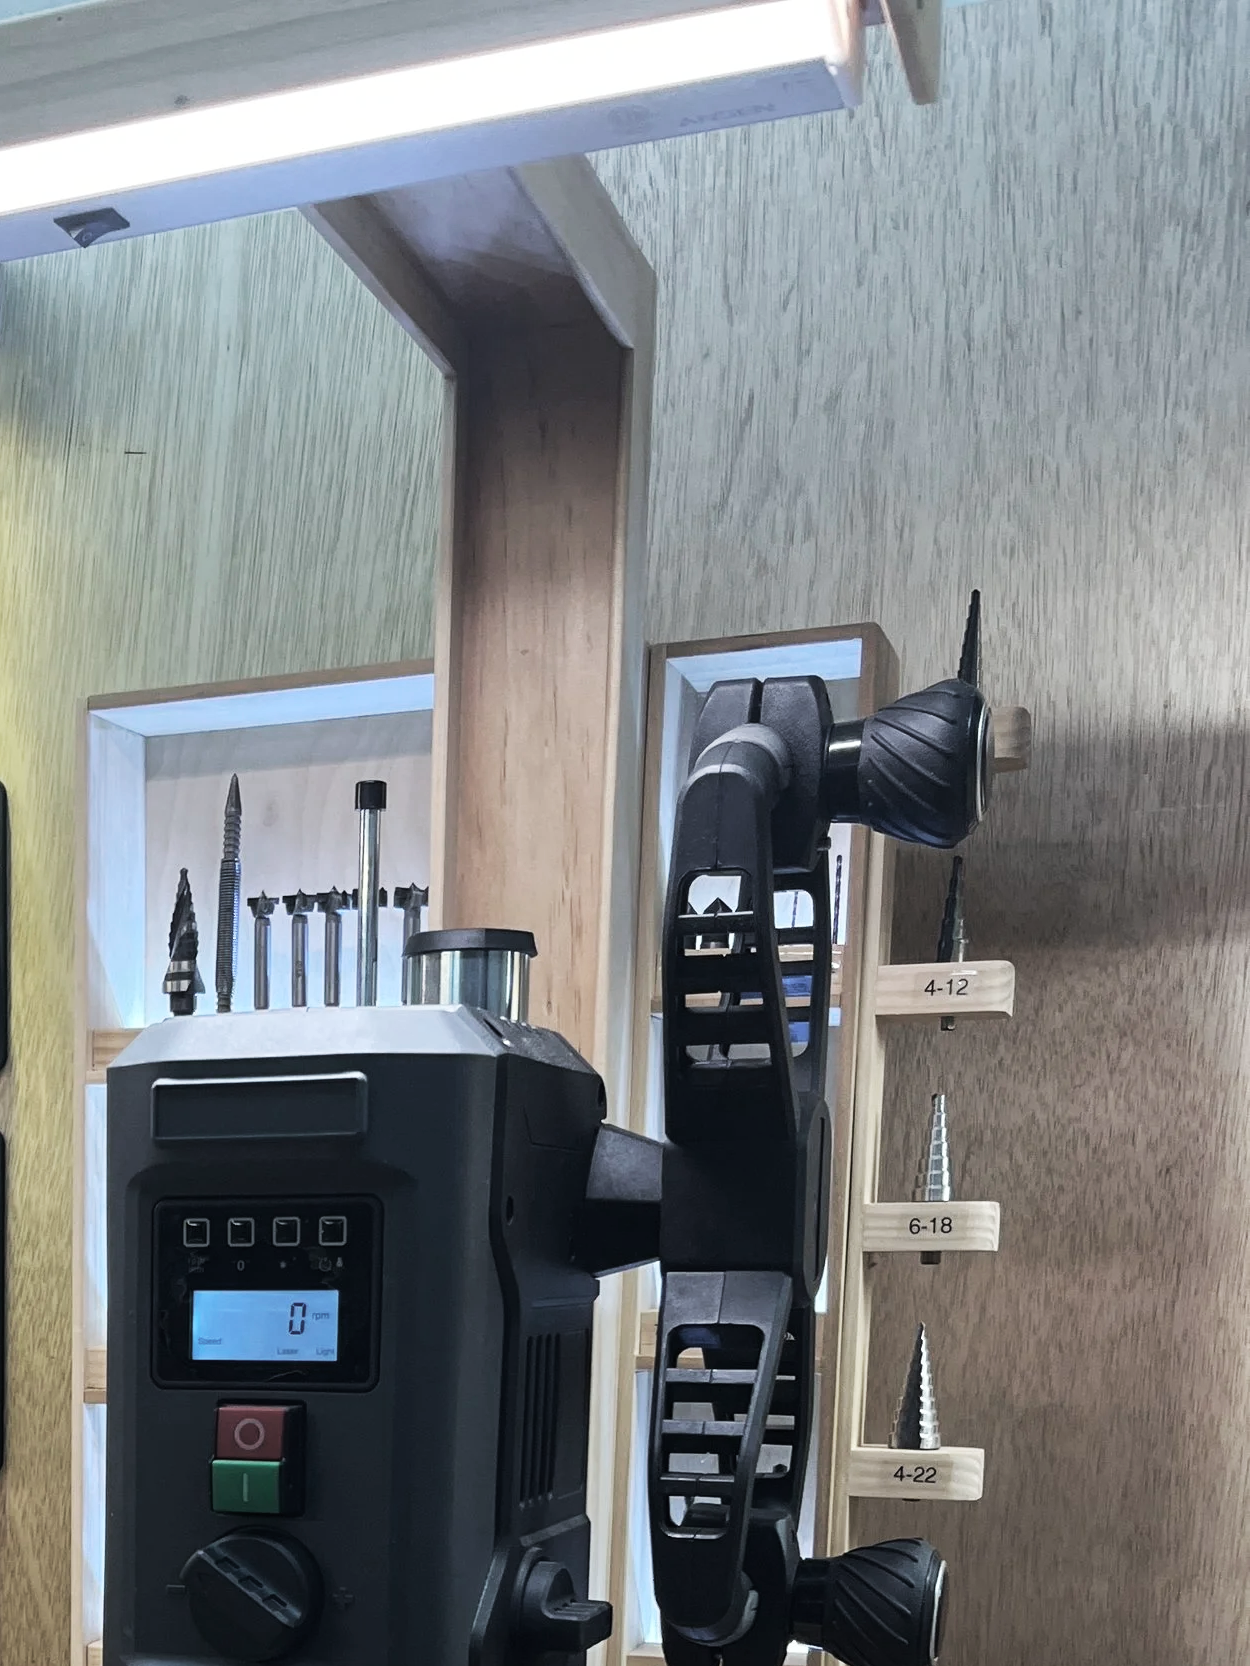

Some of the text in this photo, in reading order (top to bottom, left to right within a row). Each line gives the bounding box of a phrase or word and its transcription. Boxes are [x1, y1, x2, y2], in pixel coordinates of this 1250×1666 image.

[924, 978, 969, 996] 4-12
[909, 1217, 952, 1235] 6-18
[288, 1302, 330, 1335] 0 rpm
[893, 1465, 937, 1484] 4-22
